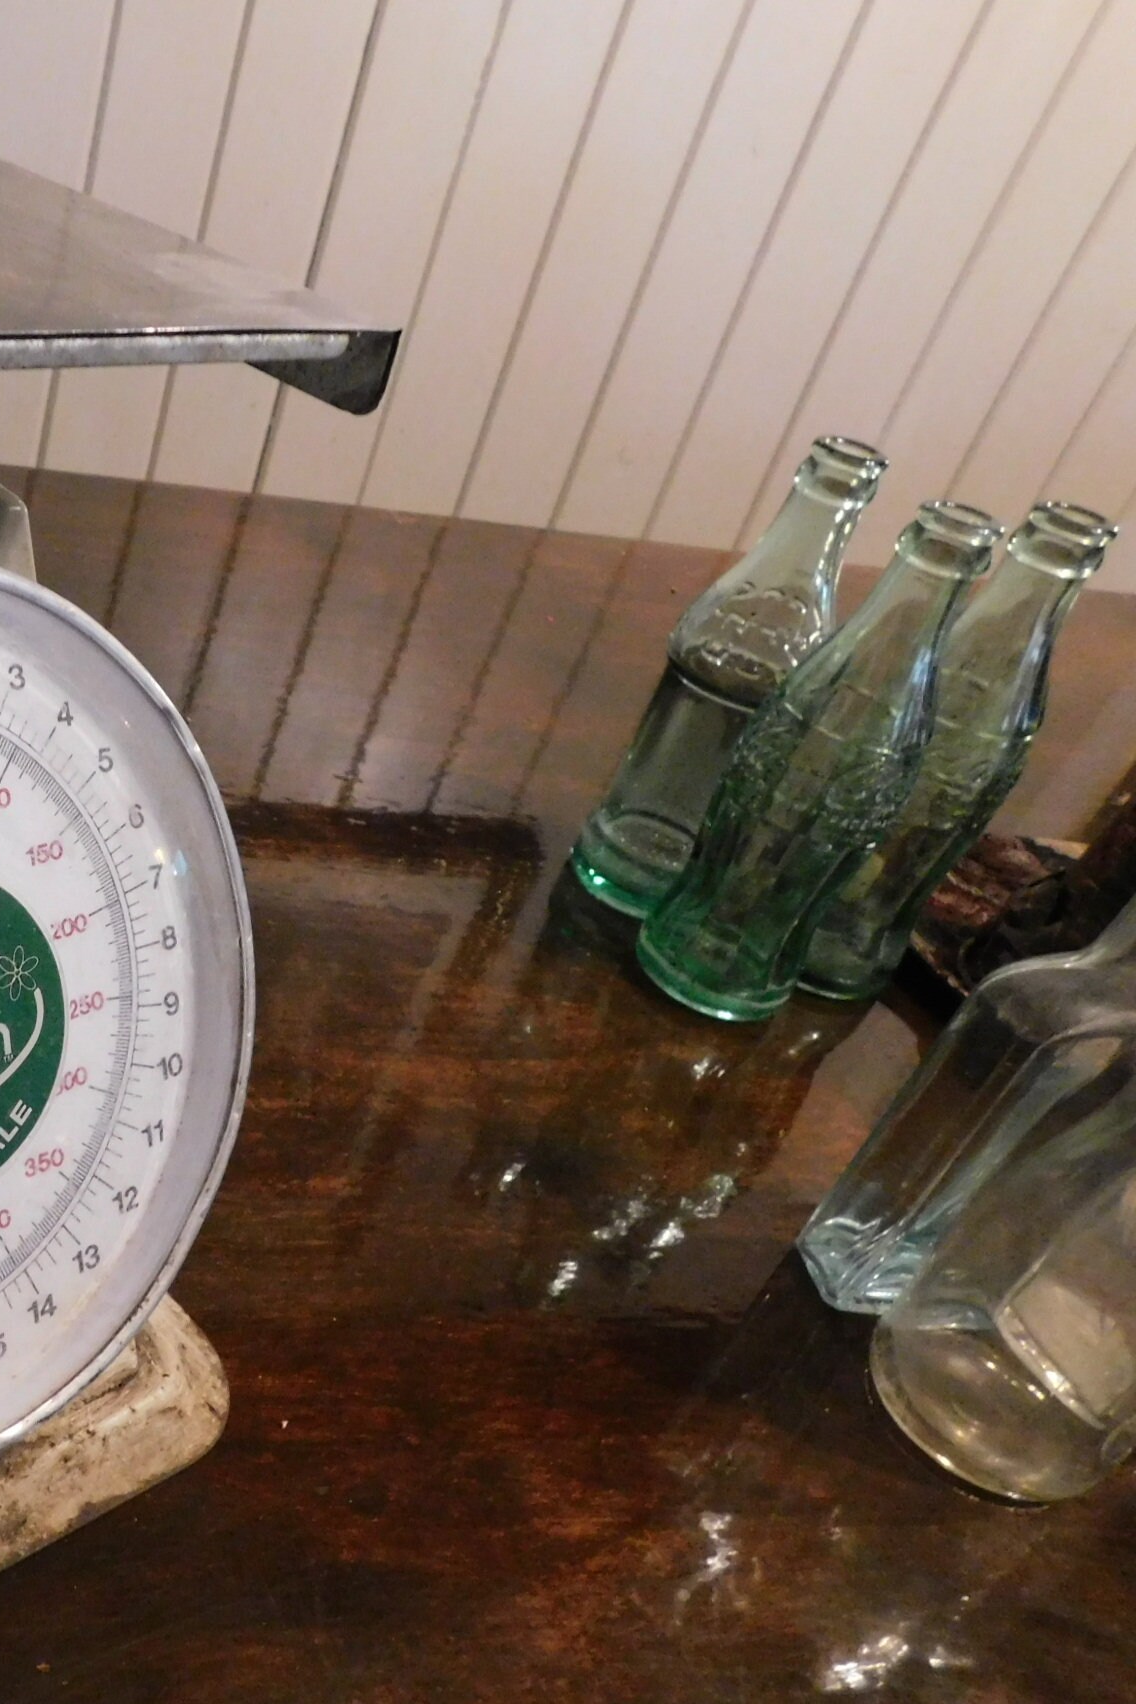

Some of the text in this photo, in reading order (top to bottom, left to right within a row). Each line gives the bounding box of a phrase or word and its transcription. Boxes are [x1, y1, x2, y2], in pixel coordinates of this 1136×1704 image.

[8, 664, 26, 690] 3
[57, 703, 74, 727] 4
[98, 748, 114, 773] 5
[128, 804, 145, 829] 6
[25, 840, 64, 867] 150
[148, 864, 163, 889] 7
[50, 914, 88, 941] 200
[161, 925, 178, 950] 8
[70, 991, 104, 1020] 250
[164, 992, 179, 1016] 9
[157, 1053, 183, 1080] 10
[56, 1067, 88, 1096] 00
[141, 1119, 164, 1147] 11
[25, 1148, 64, 1178] 350
[113, 1186, 139, 1214] 12
[72, 1245, 101, 1274] 13
[27, 1294, 57, 1324] 14
